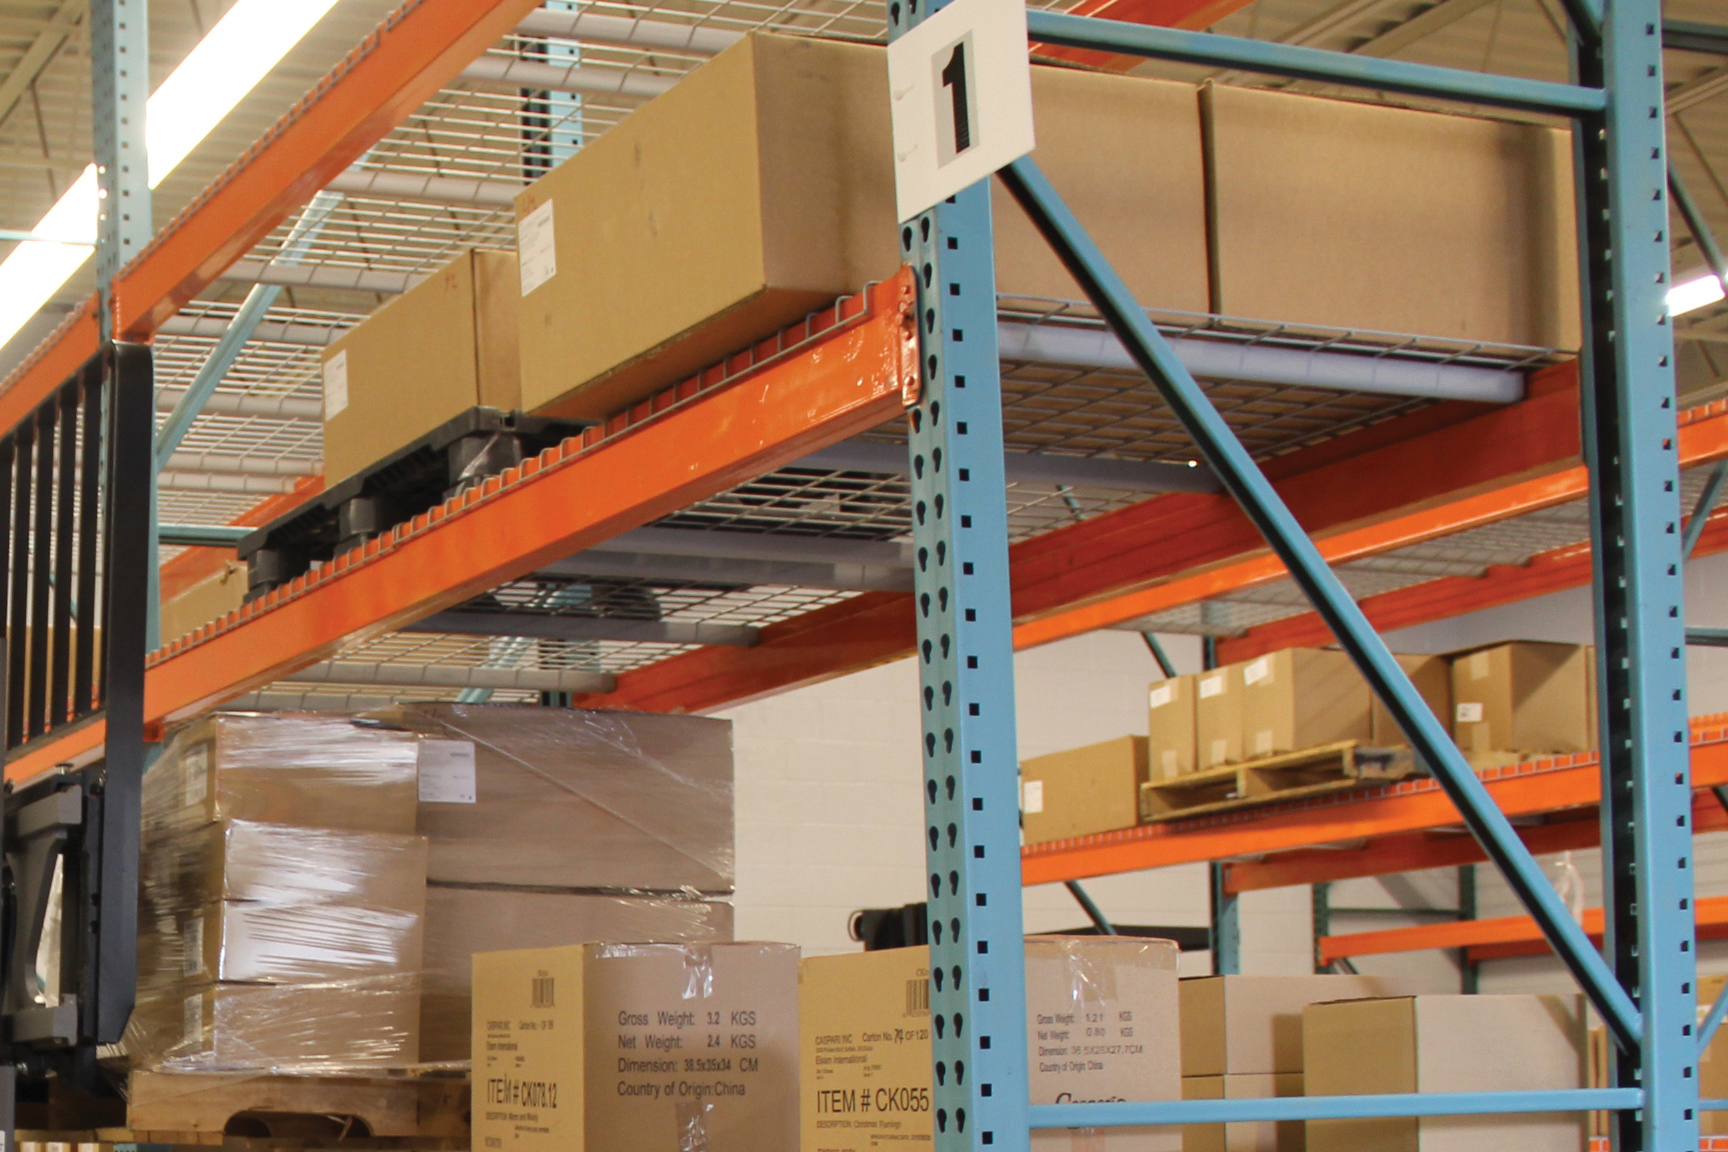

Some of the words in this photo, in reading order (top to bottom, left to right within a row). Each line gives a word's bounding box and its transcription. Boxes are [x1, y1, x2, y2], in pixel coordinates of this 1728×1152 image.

[942, 41, 970, 154] 1
[618, 1010, 649, 1026] Gross
[658, 1010, 695, 1029] Weight:
[707, 1011, 720, 1025] 3.2
[731, 1011, 756, 1026] KGS
[1037, 1013, 1054, 1024] Gross
[1119, 1010, 1132, 1021] KGS
[862, 1032, 882, 1042] Carton
[905, 1030, 915, 1041] OF
[1037, 1030, 1048, 1040] Net
[1085, 1027, 1105, 1037] 0.80
[1120, 1027, 1133, 1037] KGS
[618, 1034, 636, 1049] Net
[645, 1034, 683, 1052] Weight:
[707, 1034, 720, 1048] 2.4
[731, 1034, 756, 1048] KGS
[618, 1057, 678, 1073] Dimension:
[739, 1057, 759, 1072] CM
[1039, 1062, 1061, 1074] Country
[1062, 1062, 1068, 1071] of
[1087, 1060, 1104, 1070] China
[488, 1078, 511, 1104] ITEM
[513, 1078, 519, 1104] #
[617, 1081, 661, 1099] Country
[664, 1081, 675, 1096] of
[817, 1089, 856, 1113] ITEM
[861, 1088, 871, 1112] #
[875, 1087, 930, 1112] CK055
